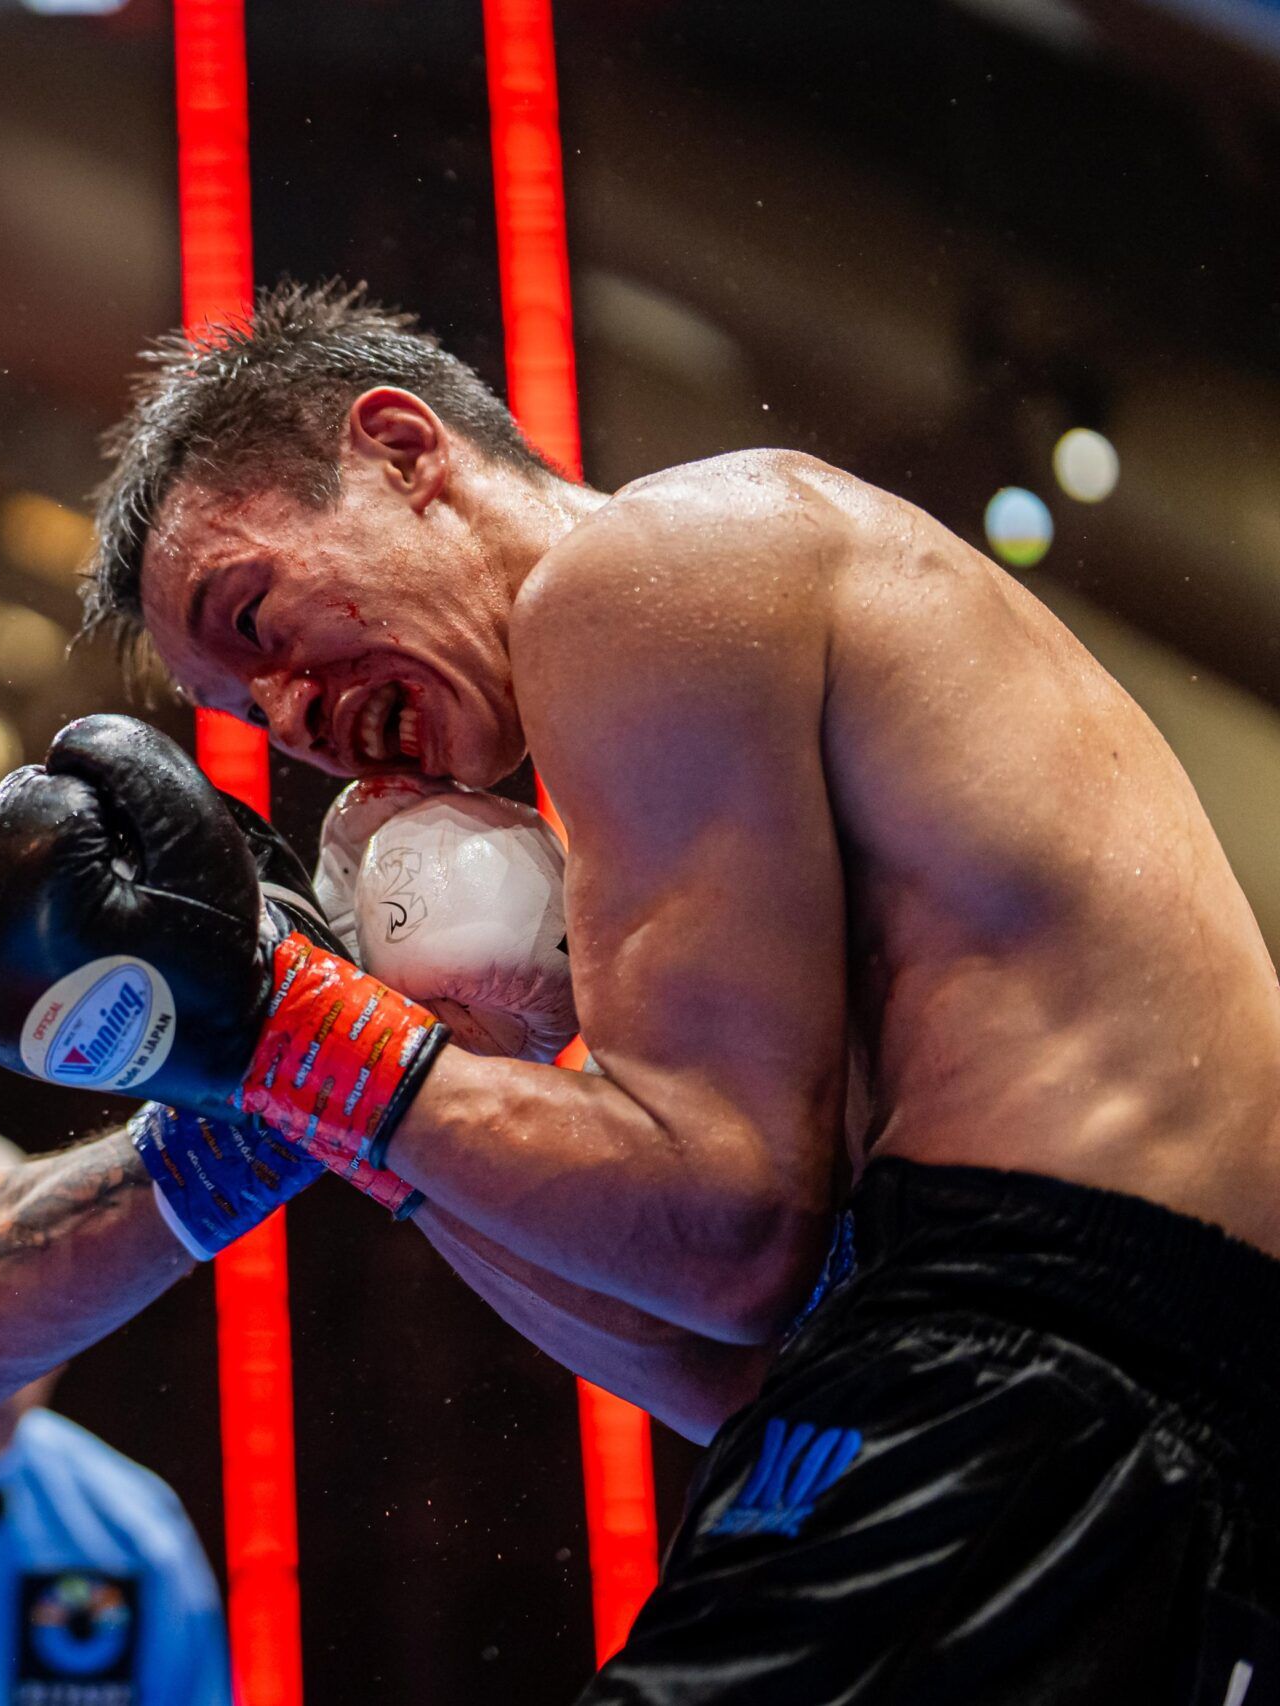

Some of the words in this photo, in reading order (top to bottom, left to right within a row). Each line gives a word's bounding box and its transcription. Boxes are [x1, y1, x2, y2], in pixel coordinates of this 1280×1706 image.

[33, 1002, 63, 1040] OFFICIAL
[54, 982, 144, 1074] Winning
[134, 1055, 150, 1072] in
[144, 1013, 173, 1055] JAPAN
[354, 1066, 371, 1091] pro
